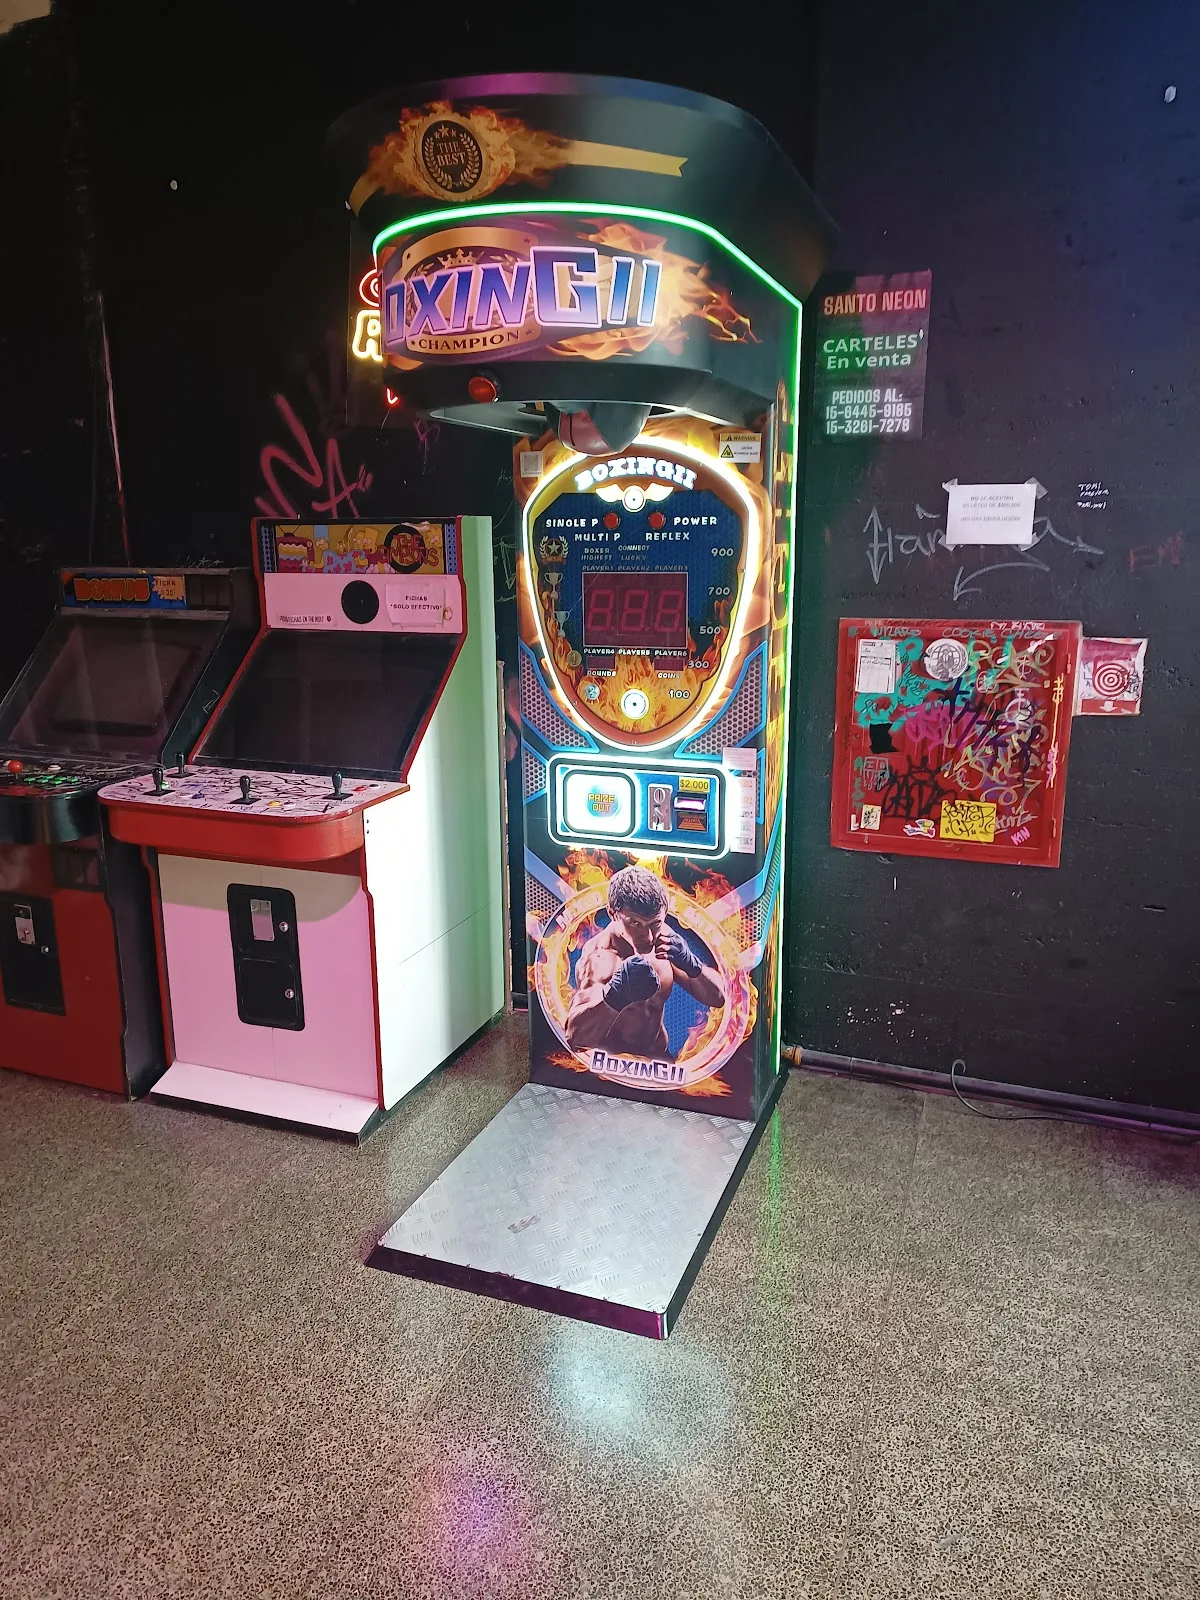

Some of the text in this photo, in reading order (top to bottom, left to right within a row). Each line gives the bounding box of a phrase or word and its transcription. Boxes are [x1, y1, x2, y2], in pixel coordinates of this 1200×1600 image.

[437, 141, 459, 153] THE
[437, 152, 466, 166] BEST
[385, 246, 663, 346] OXINGII
[824, 289, 927, 316] SANTO NEON
[418, 330, 520, 351] CHAMPION
[827, 353, 912, 370] En venta
[832, 389, 880, 404] PEDIDOS
[574, 457, 698, 491] BOXINGII
[546, 518, 600, 528] SINGLE P
[673, 516, 718, 526] POWER
[574, 532, 621, 542] MULTI P
[645, 532, 690, 541] REFLEX
[391, 535, 425, 550] THE
[711, 547, 734, 557] 900
[707, 586, 731, 596] 700
[699, 625, 722, 635] 500
[688, 660, 710, 669] 300
[668, 689, 691, 699] 100
[679, 779, 709, 790] $2.000
[588, 793, 615, 803] PRIZE
[592, 803, 611, 812] OUT
[592, 1050, 685, 1082] BOXINGII
